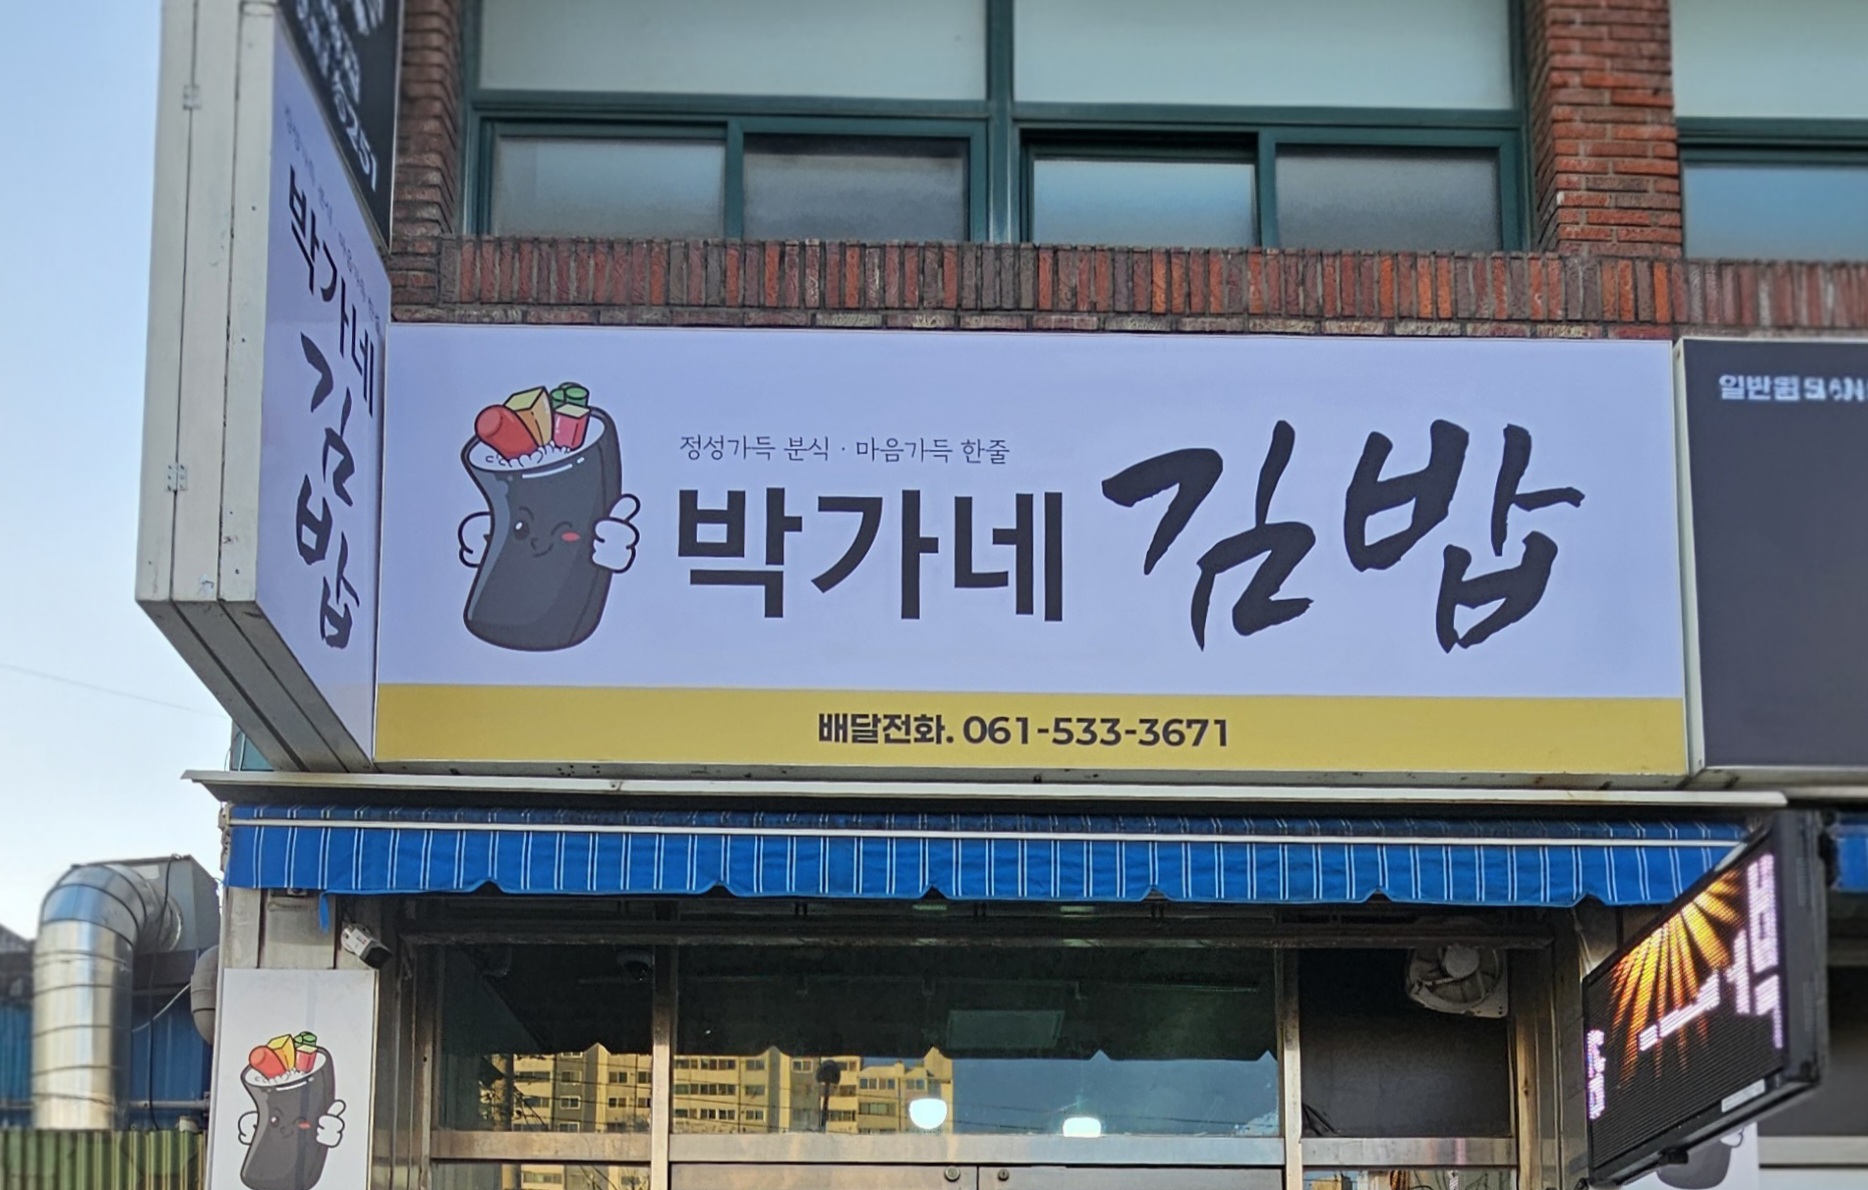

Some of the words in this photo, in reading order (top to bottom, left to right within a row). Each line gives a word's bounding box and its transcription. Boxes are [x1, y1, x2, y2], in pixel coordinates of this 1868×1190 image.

[288, 162, 375, 418] 박가네
[295, 332, 362, 650] 김밥
[678, 487, 1064, 622] 박가네
[1102, 418, 1586, 654] 김밥
[680, 434, 776, 462] 정성가득
[784, 436, 830, 463] 분식
[855, 438, 953, 464] 마음가득
[961, 438, 1010, 465] 한줄
[817, 712, 955, 746] 배달전화.
[963, 715, 1230, 748] 061-533-3671
